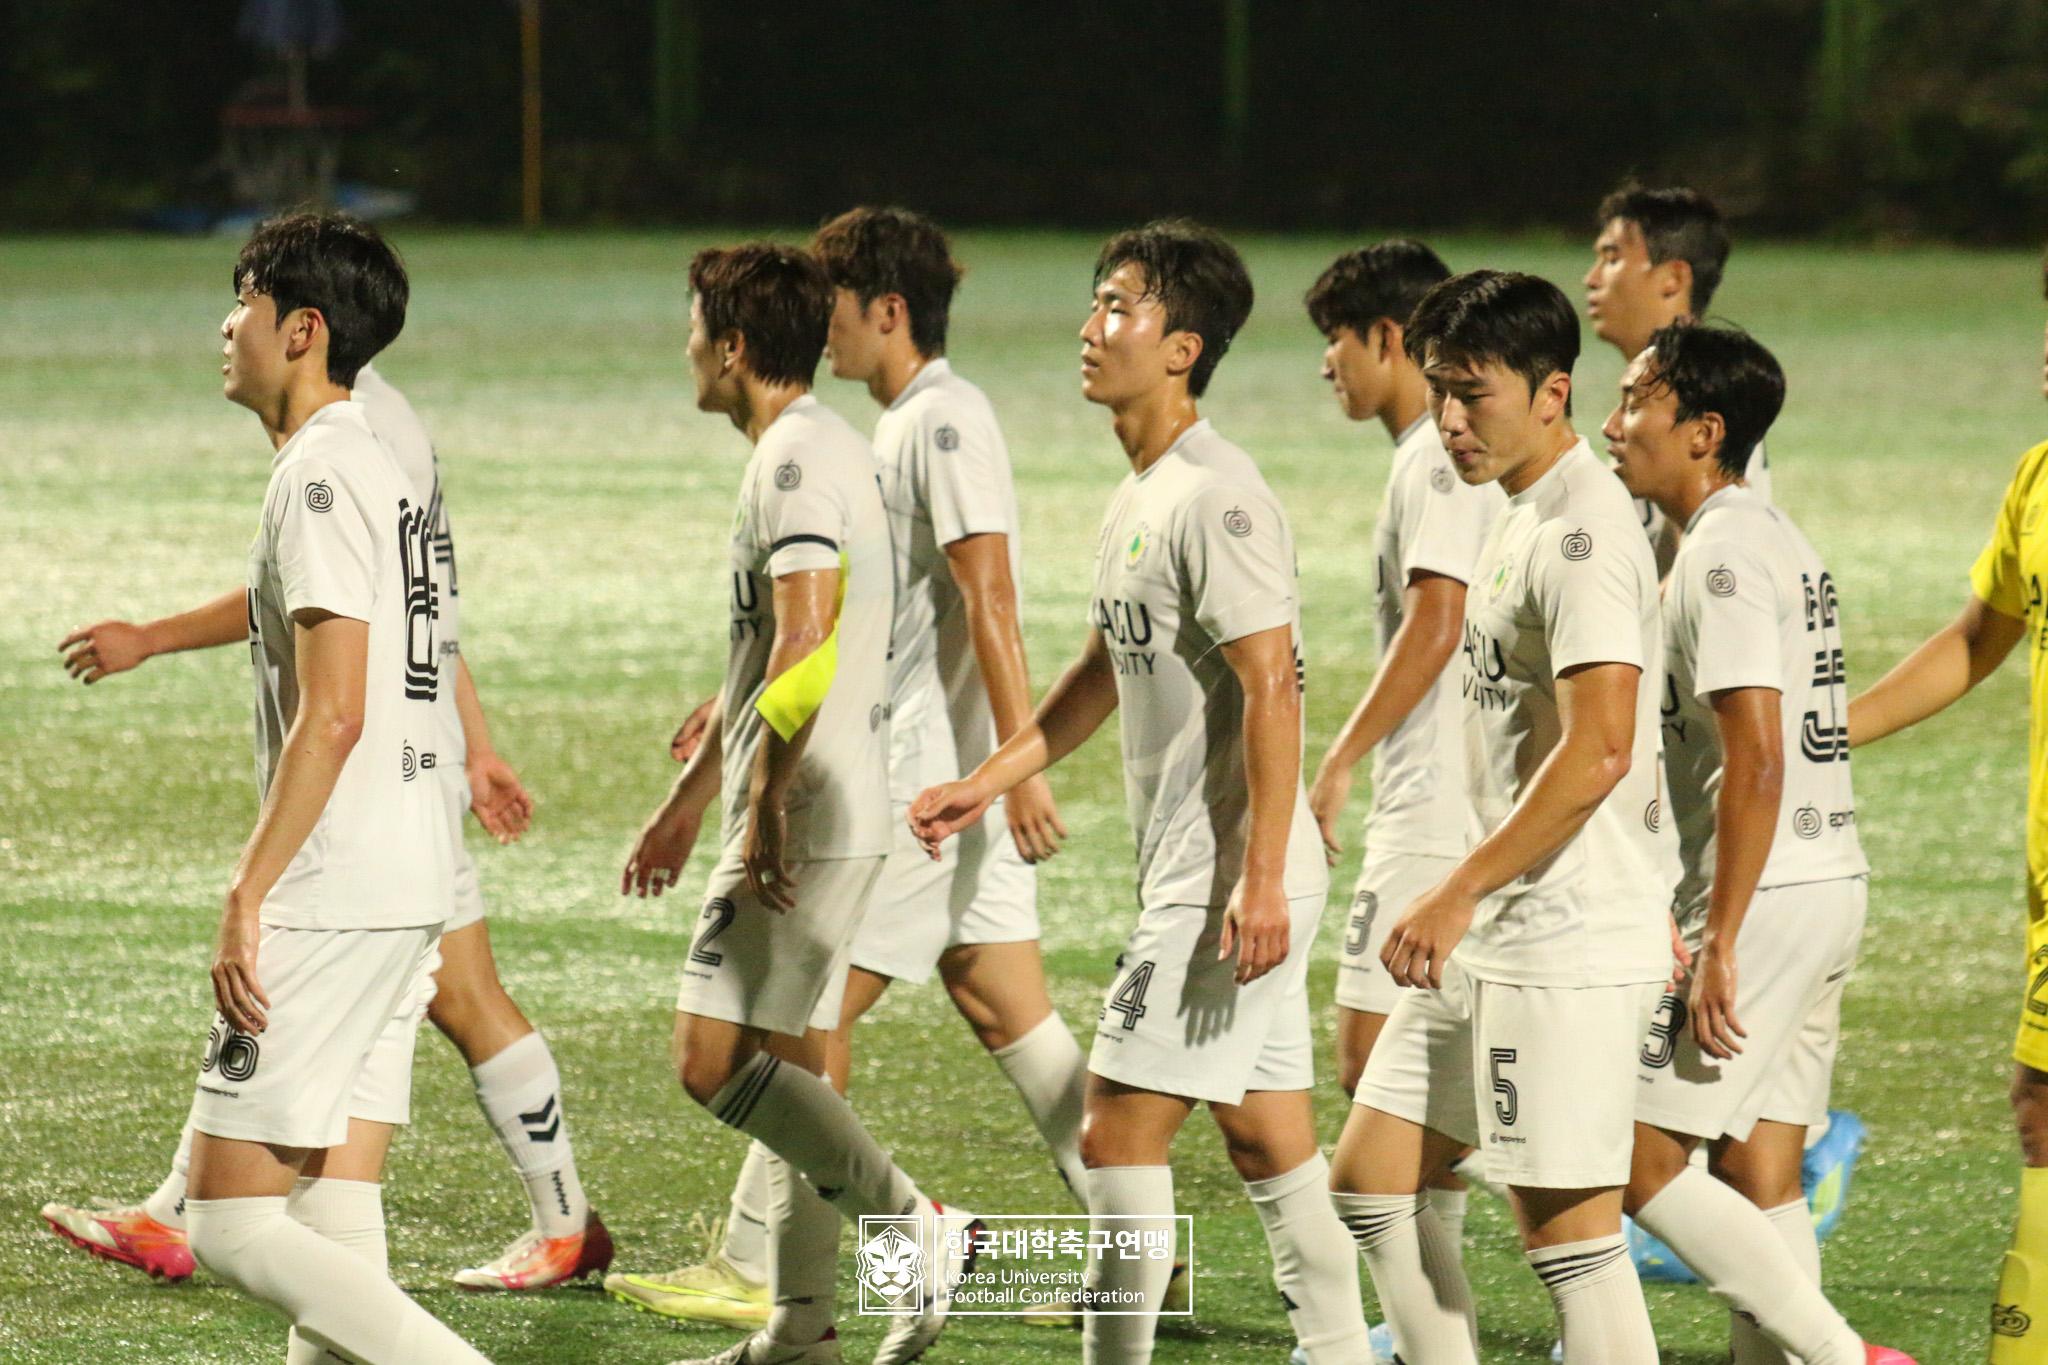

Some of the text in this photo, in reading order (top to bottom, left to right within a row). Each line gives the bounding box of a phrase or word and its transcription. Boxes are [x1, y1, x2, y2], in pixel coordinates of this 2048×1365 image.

[691, 897, 735, 967] 2
[1346, 890, 1378, 955] 3
[1110, 960, 1156, 1031] 4
[1490, 1047, 1518, 1126] 5
